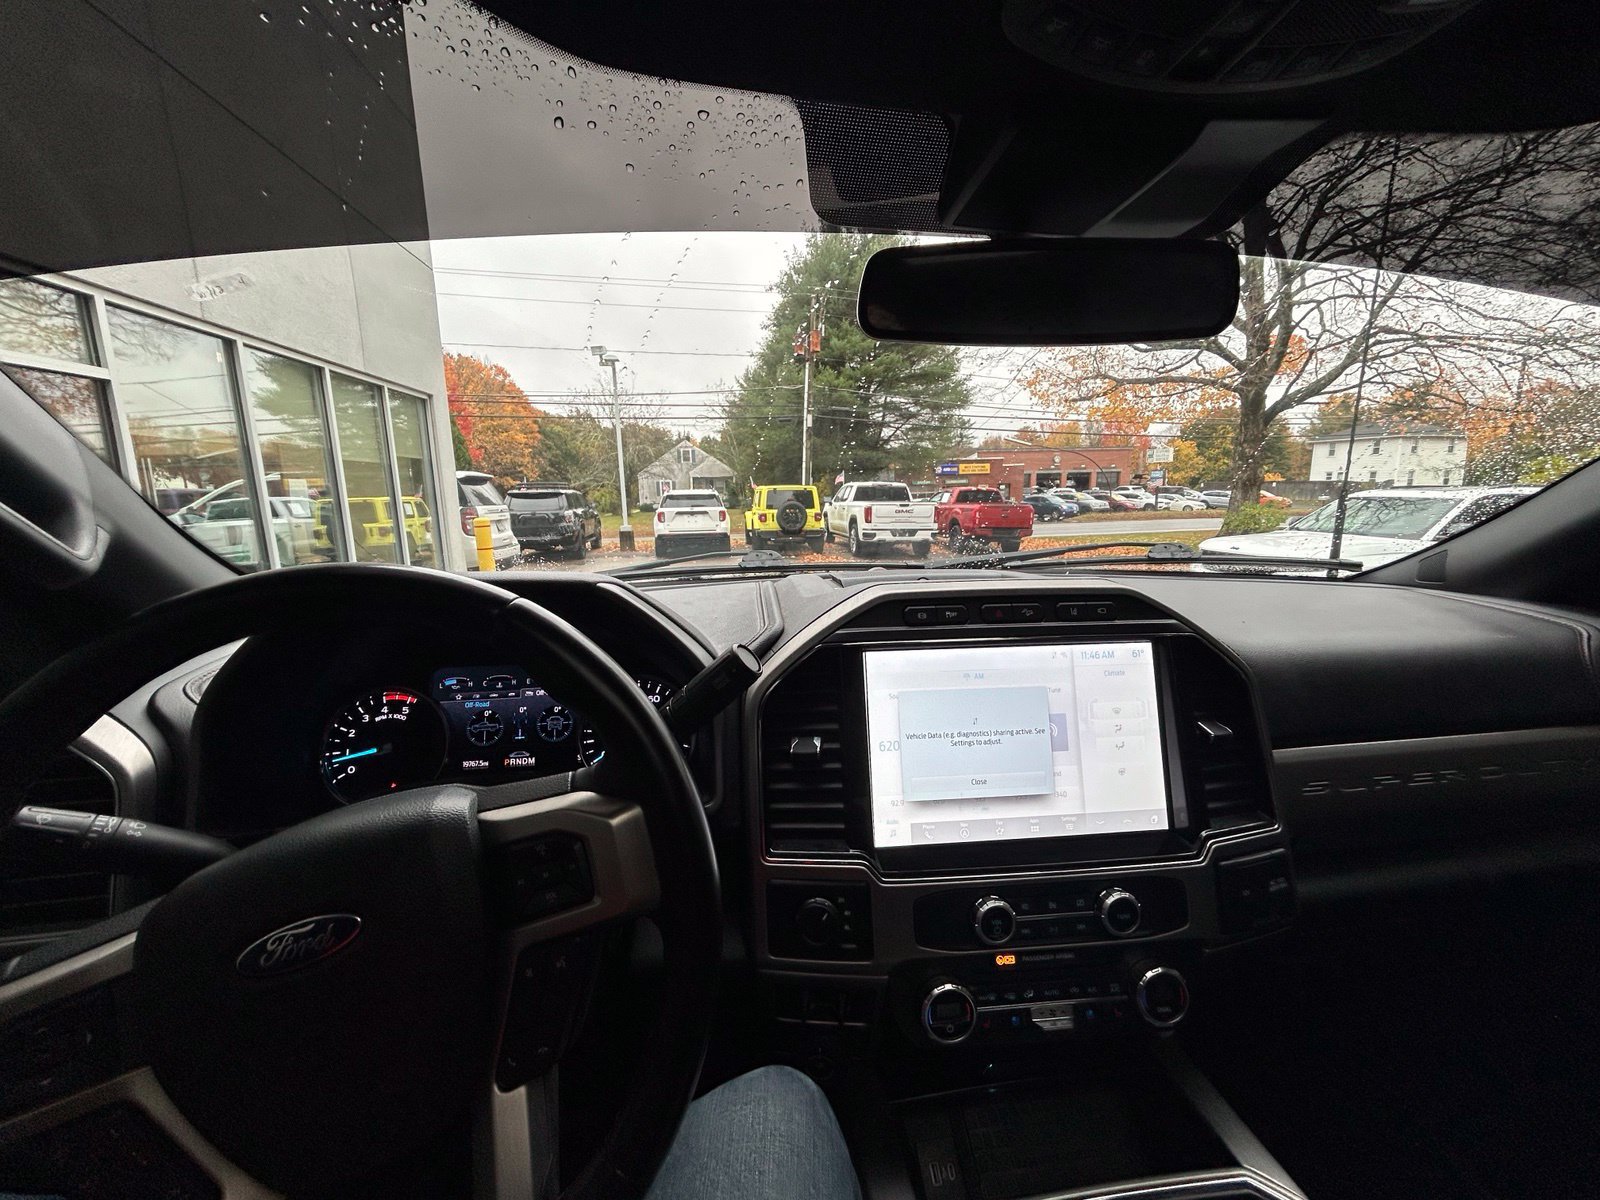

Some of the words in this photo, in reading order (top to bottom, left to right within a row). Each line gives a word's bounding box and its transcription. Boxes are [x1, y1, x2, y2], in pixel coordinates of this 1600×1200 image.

[1081, 651, 1101, 660] 11:46
[1102, 650, 1115, 659] AM
[1104, 669, 1126, 677] Climate
[464, 701, 490, 709] Off-Road
[402, 706, 410, 714] 5
[362, 714, 369, 722] 3
[374, 714, 387, 723] RPM
[348, 729, 356, 737] 2
[905, 732, 927, 740] Vehicle
[957, 730, 992, 739] diagnostics)
[993, 729, 1014, 737] sharing
[1034, 727, 1046, 735] See
[879, 740, 900, 752] 620
[950, 739, 975, 747] Settings
[504, 757, 536, 767] PRNDM
[347, 765, 356, 774] 0
[971, 778, 988, 786] Close
[261, 922, 336, 967] Ford
